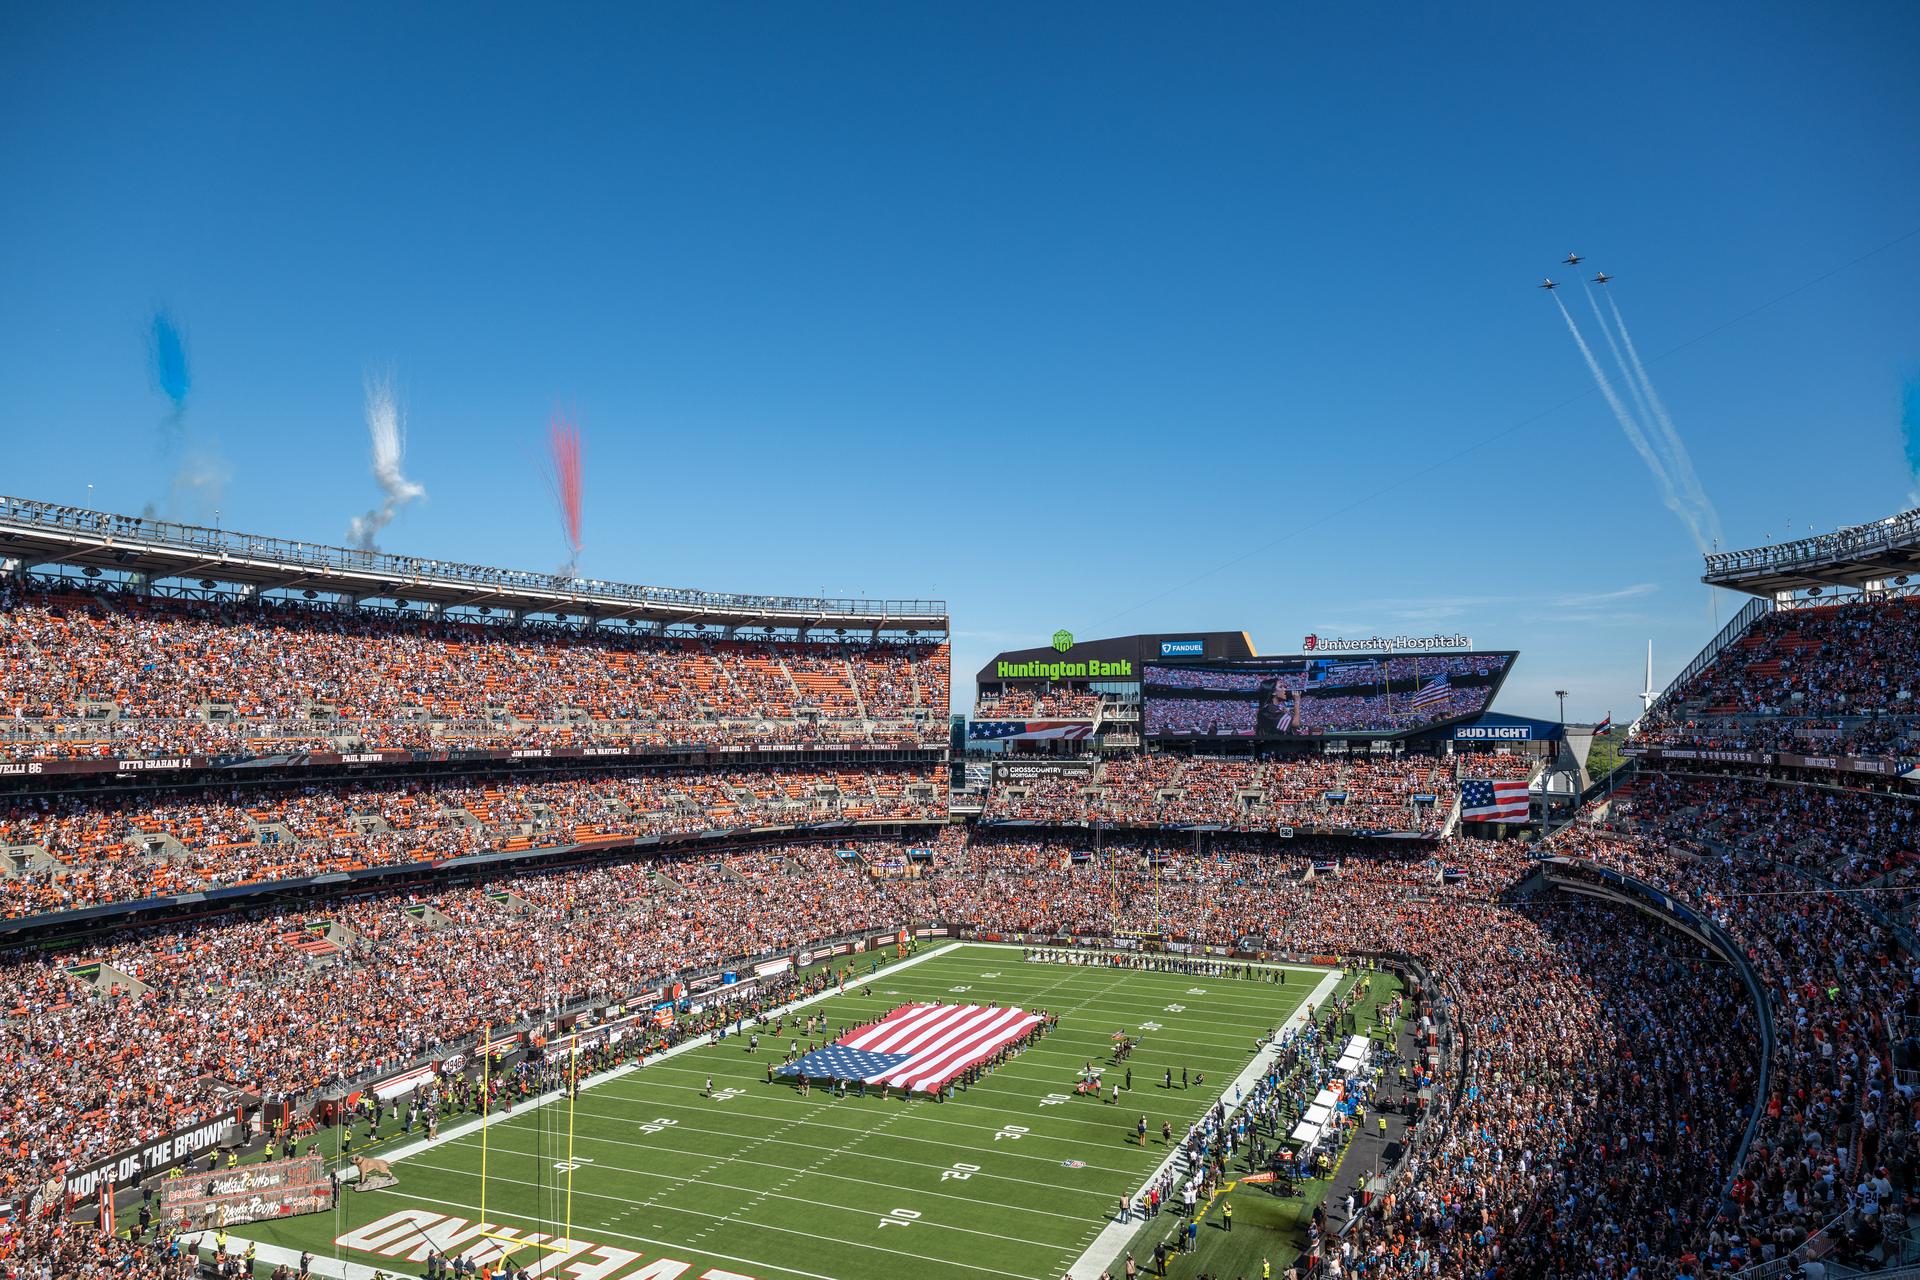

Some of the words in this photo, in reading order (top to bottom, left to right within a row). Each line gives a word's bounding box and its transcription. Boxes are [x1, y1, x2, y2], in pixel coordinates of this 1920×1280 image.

[1172, 644, 1203, 652] FANDUEL
[1318, 637, 1392, 653] University
[1397, 634, 1468, 651] Hospitals
[997, 661, 1087, 681] Huntington
[1088, 660, 1132, 676] Bank
[1456, 728, 1486, 738] BUD
[1488, 728, 1529, 738] LIGHT
[342, 754, 359, 762] PAUL
[360, 754, 382, 762] BROWN
[544, 749, 552, 757] 32
[28, 762, 43, 774] 86
[119, 760, 144, 770] OTTO
[145, 760, 180, 768] GRAHAM
[182, 758, 192, 768] 14
[1010, 766, 1062, 774] CROSSCOUNTRY
[638, 1118, 679, 1132] 20
[995, 1124, 1030, 1140] 30
[143, 1144, 172, 1171] THE
[942, 1162, 981, 1180] 20
[1865, 1192, 1878, 1203] 24
[879, 1208, 922, 1227] 10
